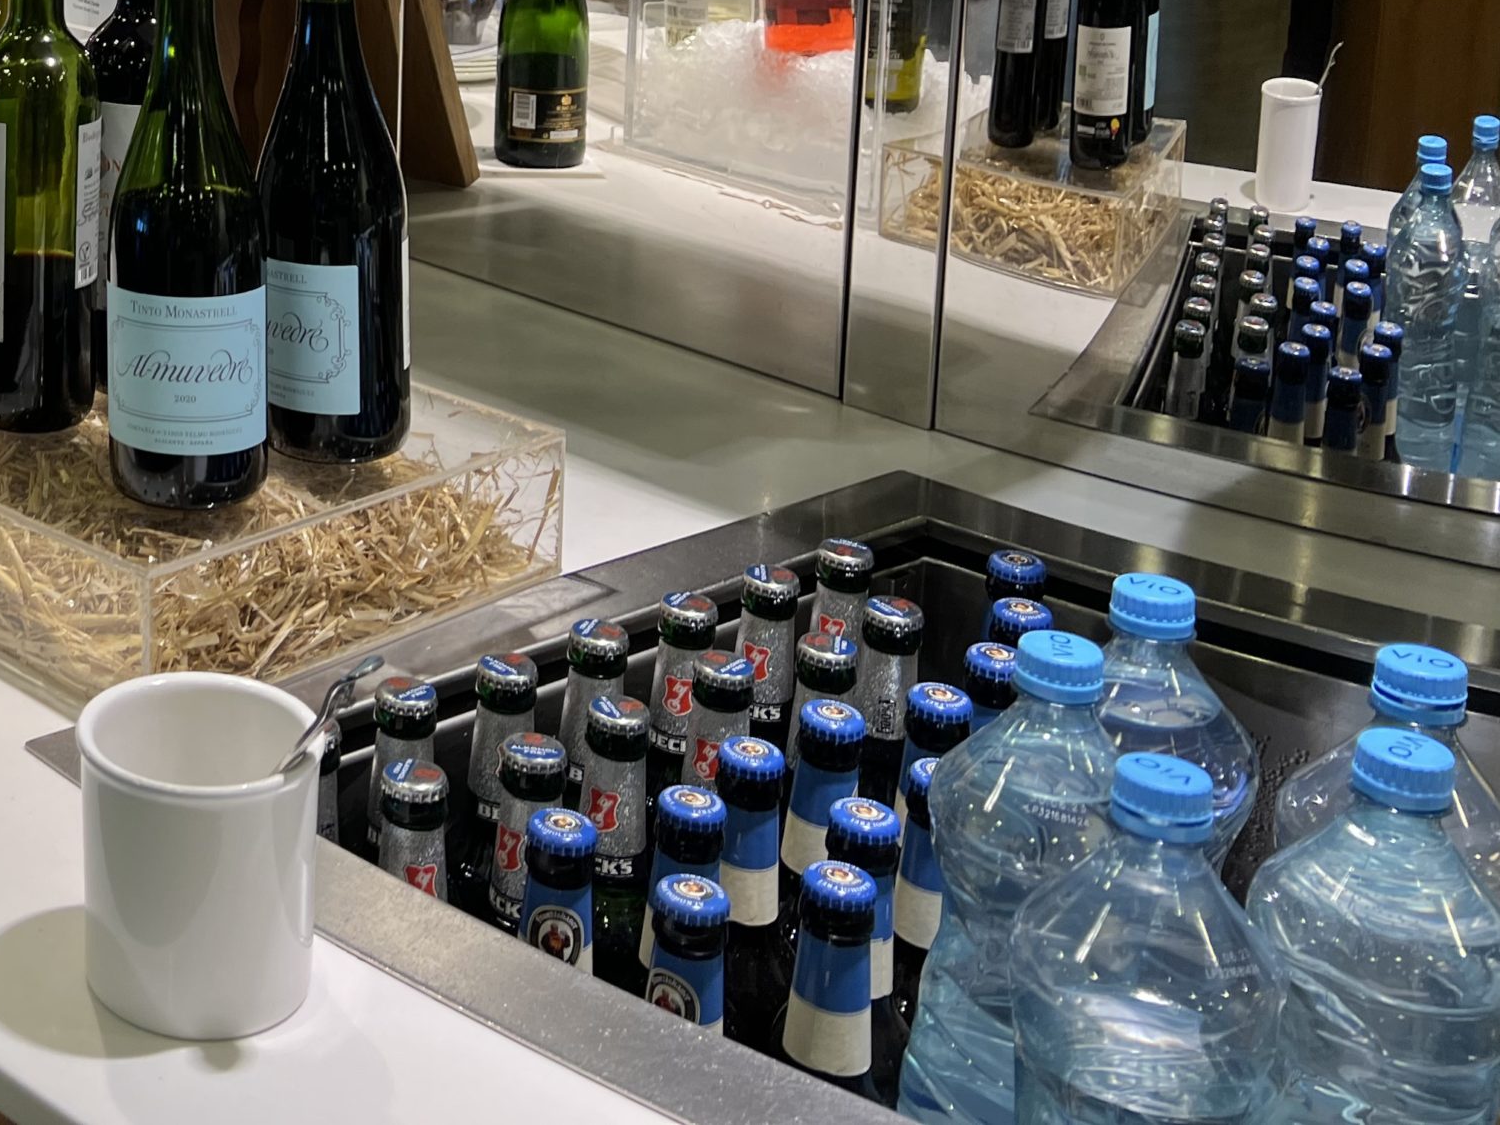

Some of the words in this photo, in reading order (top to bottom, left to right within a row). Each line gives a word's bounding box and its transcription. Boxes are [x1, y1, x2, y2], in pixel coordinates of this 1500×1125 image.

[131, 300, 162, 317] TINTO
[165, 304, 238, 319] MONASTRELL
[173, 394, 197, 404] 2020
[511, 743, 559, 755] ALKOHOL
